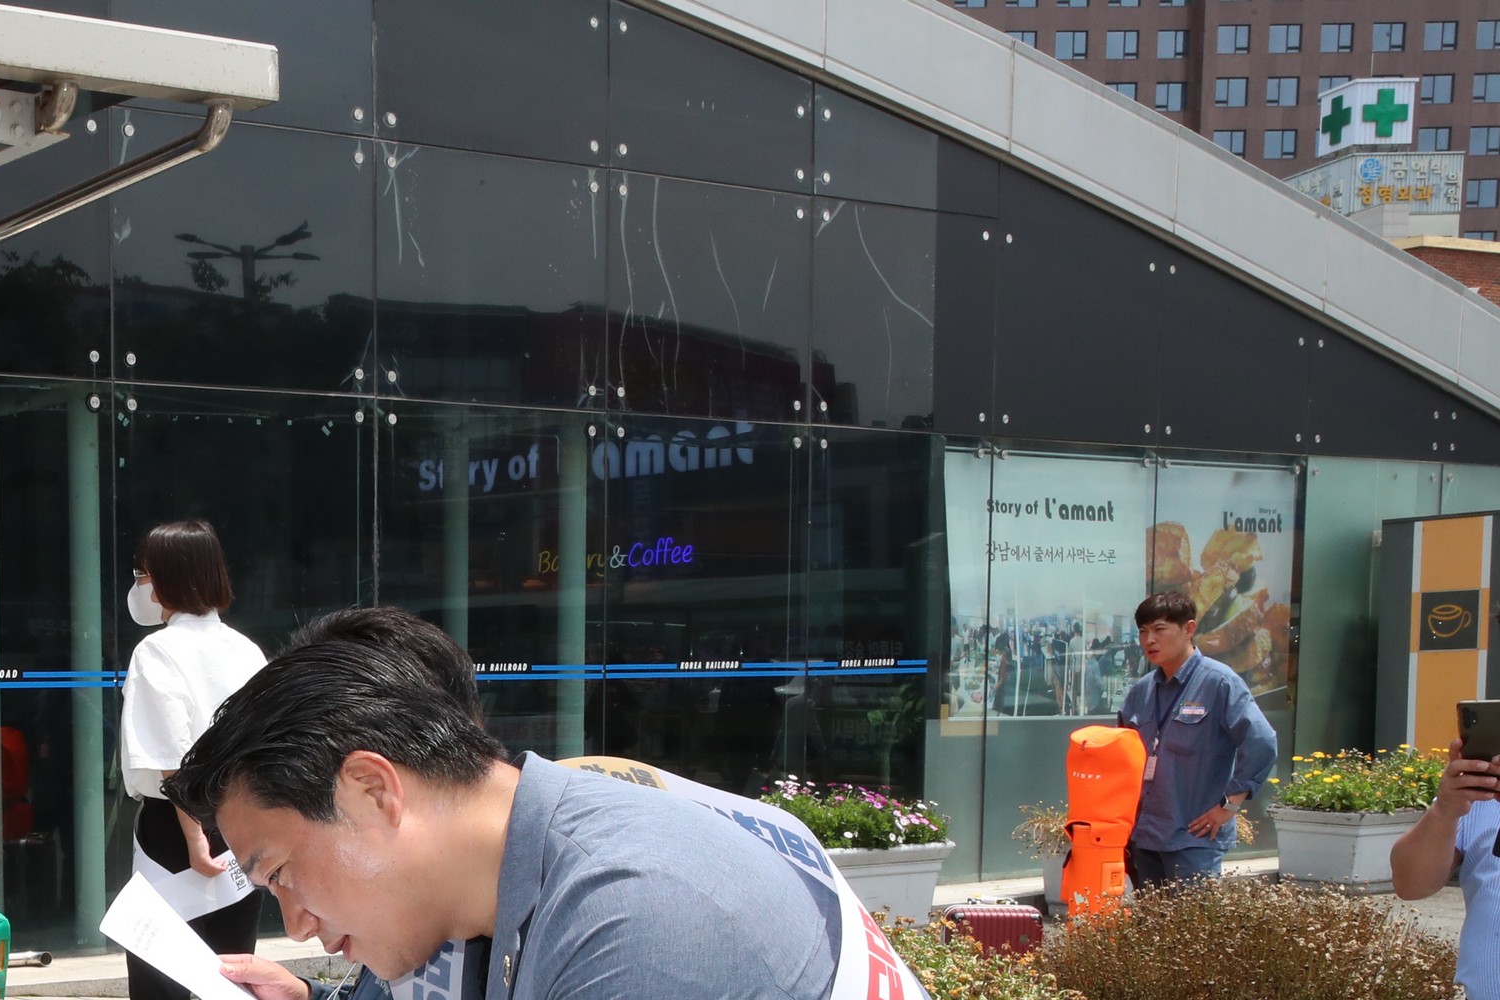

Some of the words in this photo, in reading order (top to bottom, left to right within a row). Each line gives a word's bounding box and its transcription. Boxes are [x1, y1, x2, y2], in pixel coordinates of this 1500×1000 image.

[1358, 184, 1433, 205] 정형외과
[508, 443, 539, 482] of
[986, 498, 1022, 518] Story
[1025, 500, 1038, 515] of
[1033, 546, 1063, 563] 줄서서
[1066, 546, 1096, 564] 사먹는
[1097, 548, 1116, 565] 스콘
[489, 663, 528, 672] RAILROAD
[680, 661, 702, 670] KOREA
[705, 660, 740, 669] RAILROAD
[841, 659, 861, 667] KOREA
[863, 658, 895, 667] RAILROAD
